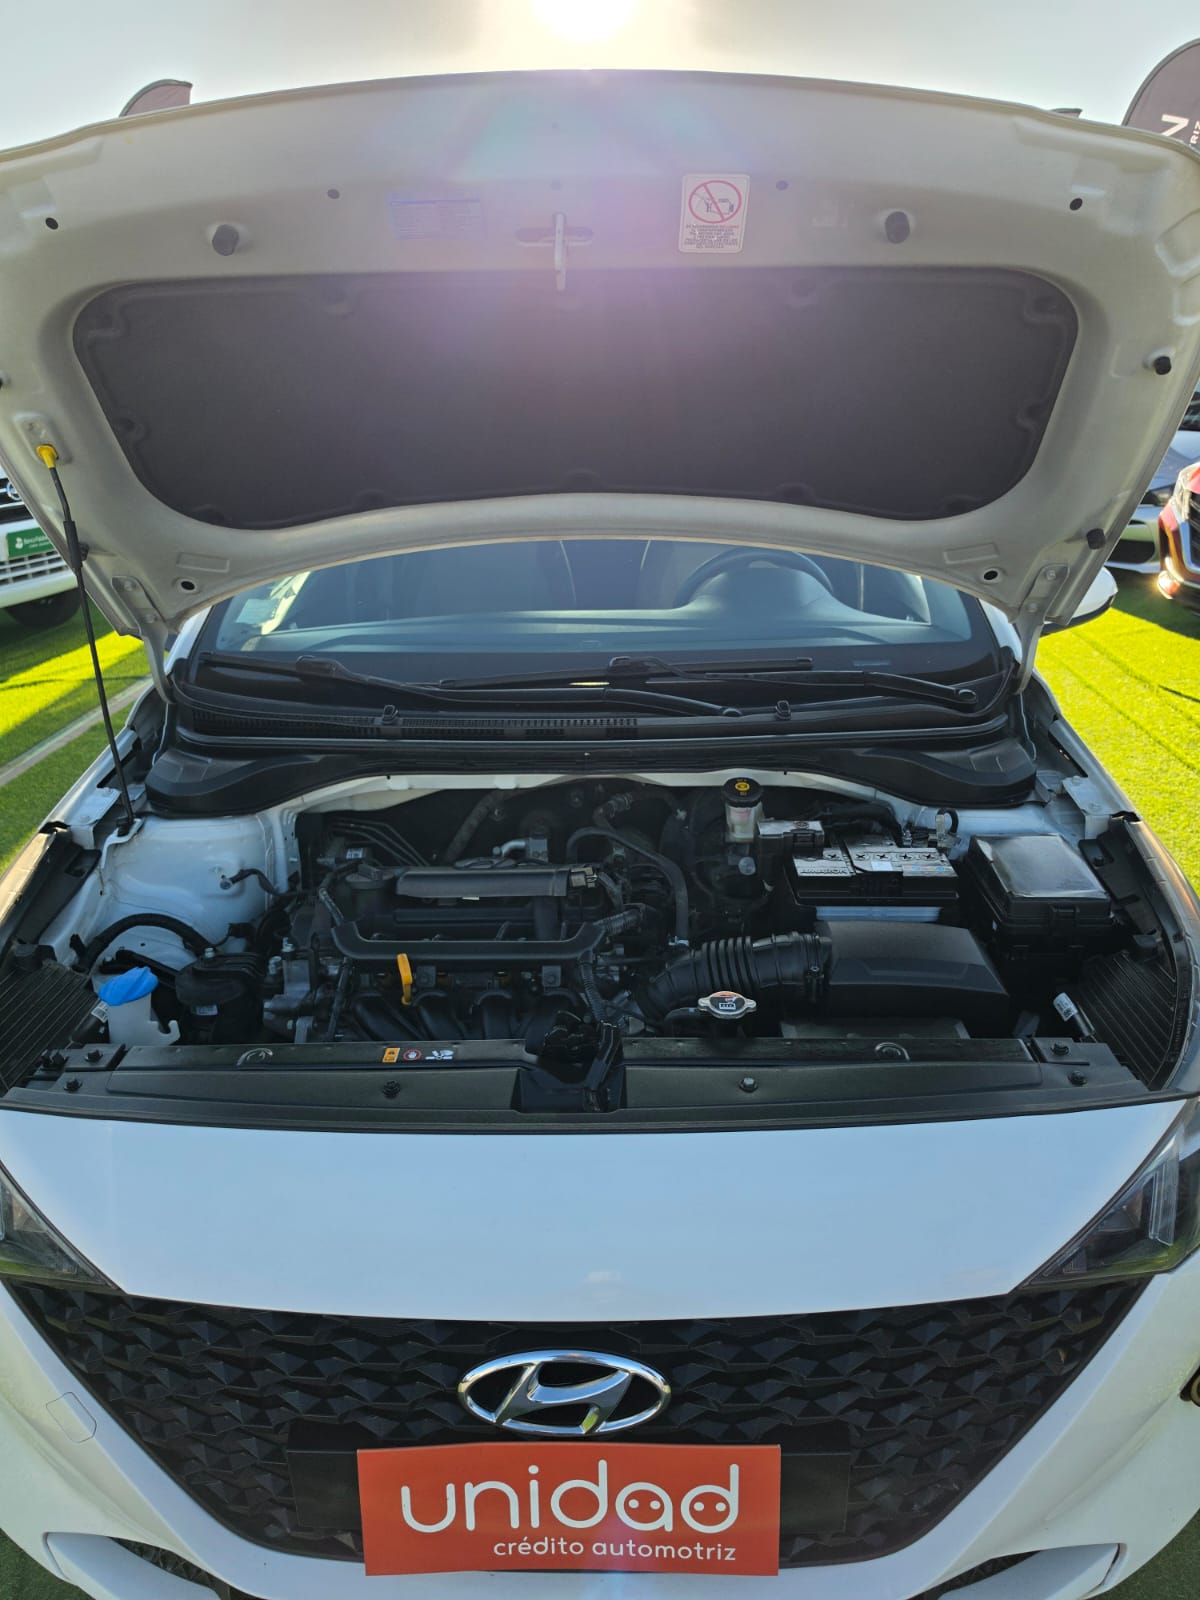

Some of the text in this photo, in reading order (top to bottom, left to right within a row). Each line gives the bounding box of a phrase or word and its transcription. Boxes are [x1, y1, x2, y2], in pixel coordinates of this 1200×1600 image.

[400, 1459, 739, 1534] unidad
[493, 1536, 737, 1562] crédito automotriz
